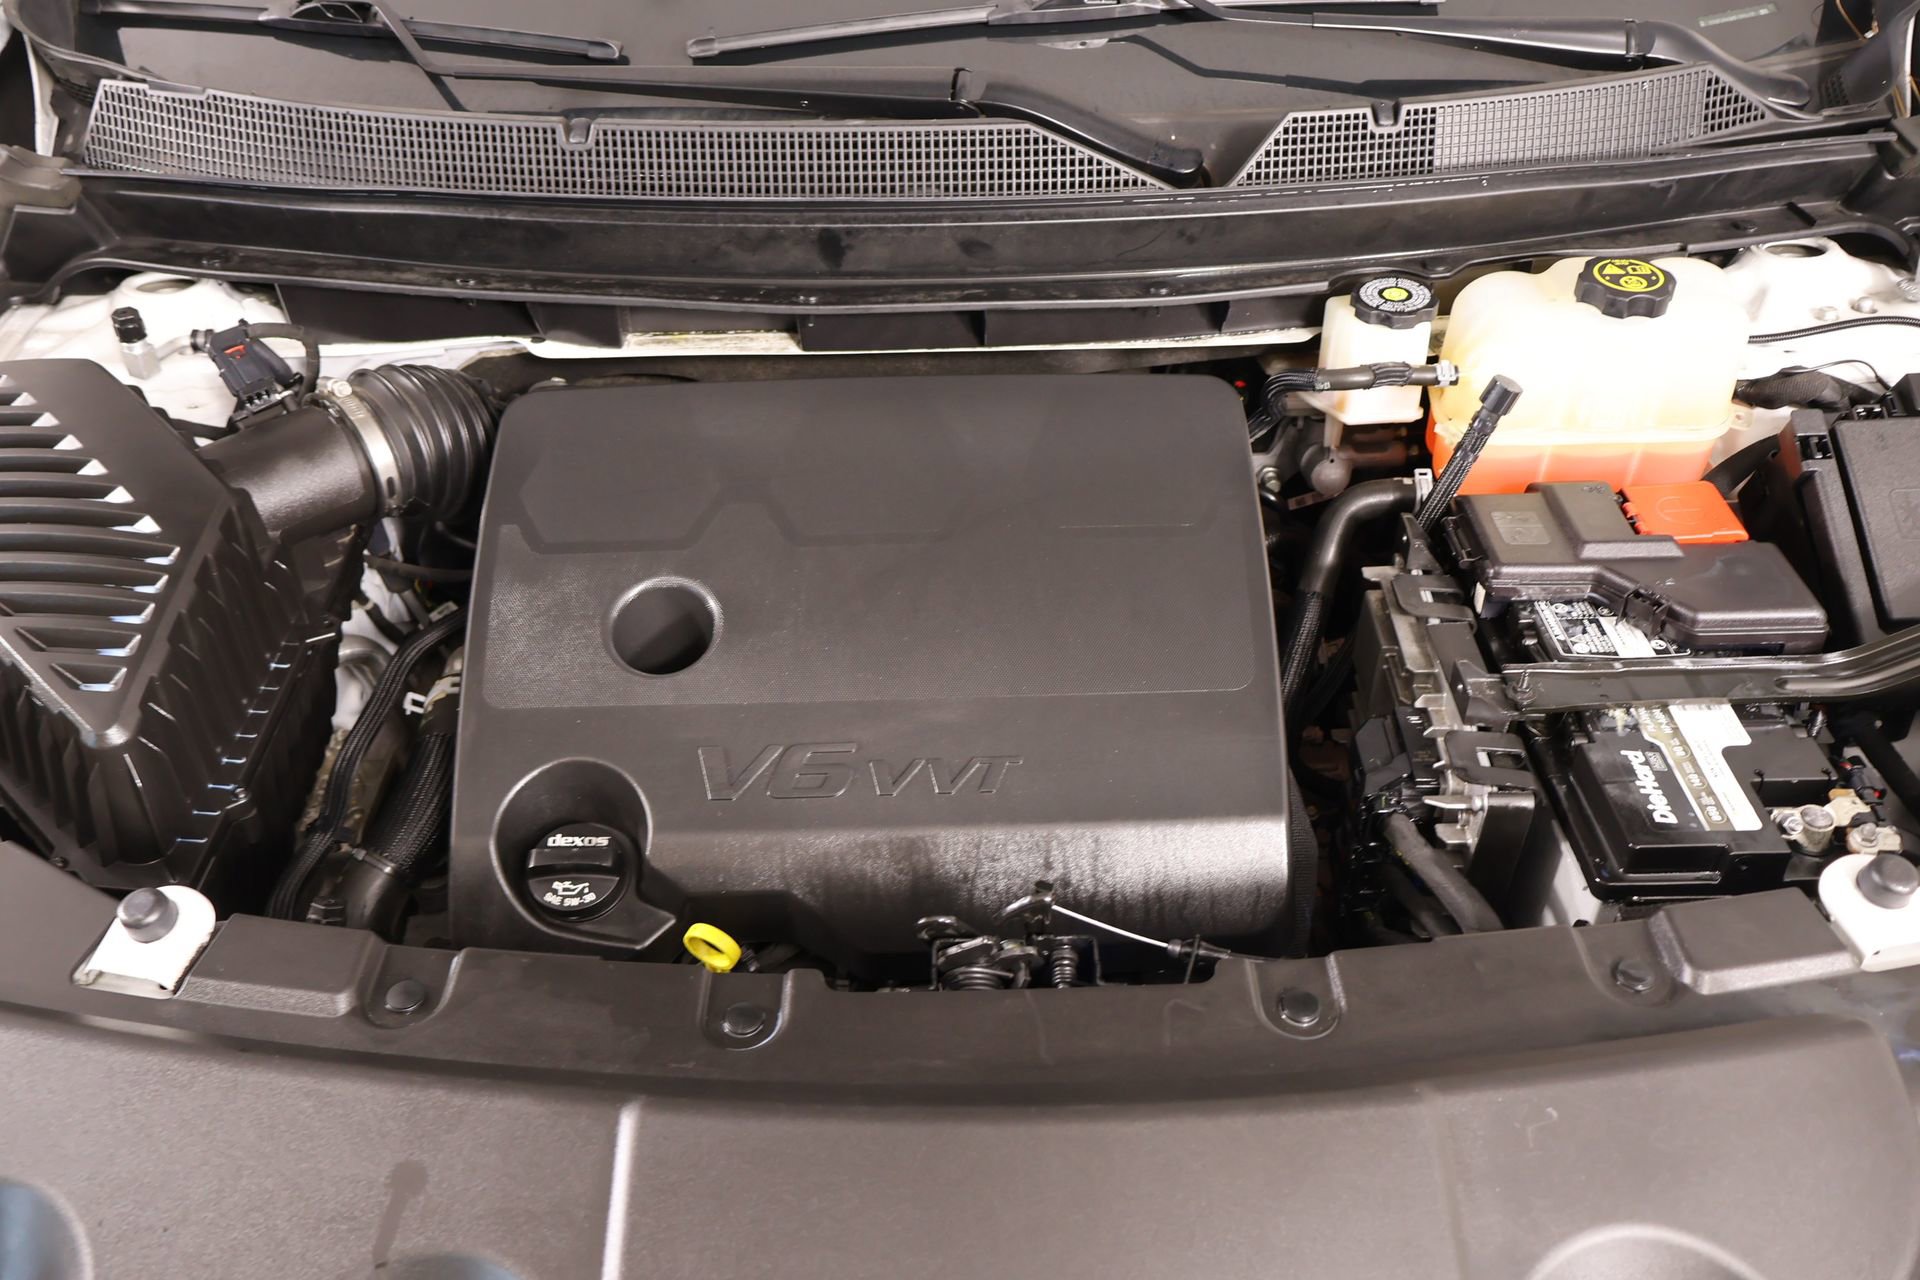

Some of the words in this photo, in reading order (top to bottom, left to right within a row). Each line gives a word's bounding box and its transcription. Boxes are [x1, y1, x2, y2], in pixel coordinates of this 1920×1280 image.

[697, 742, 858, 801] V6
[867, 756, 1024, 797] VVT
[1620, 750, 1679, 824] DieHard
[546, 833, 612, 847] dexos
[543, 892, 563, 906] SAE
